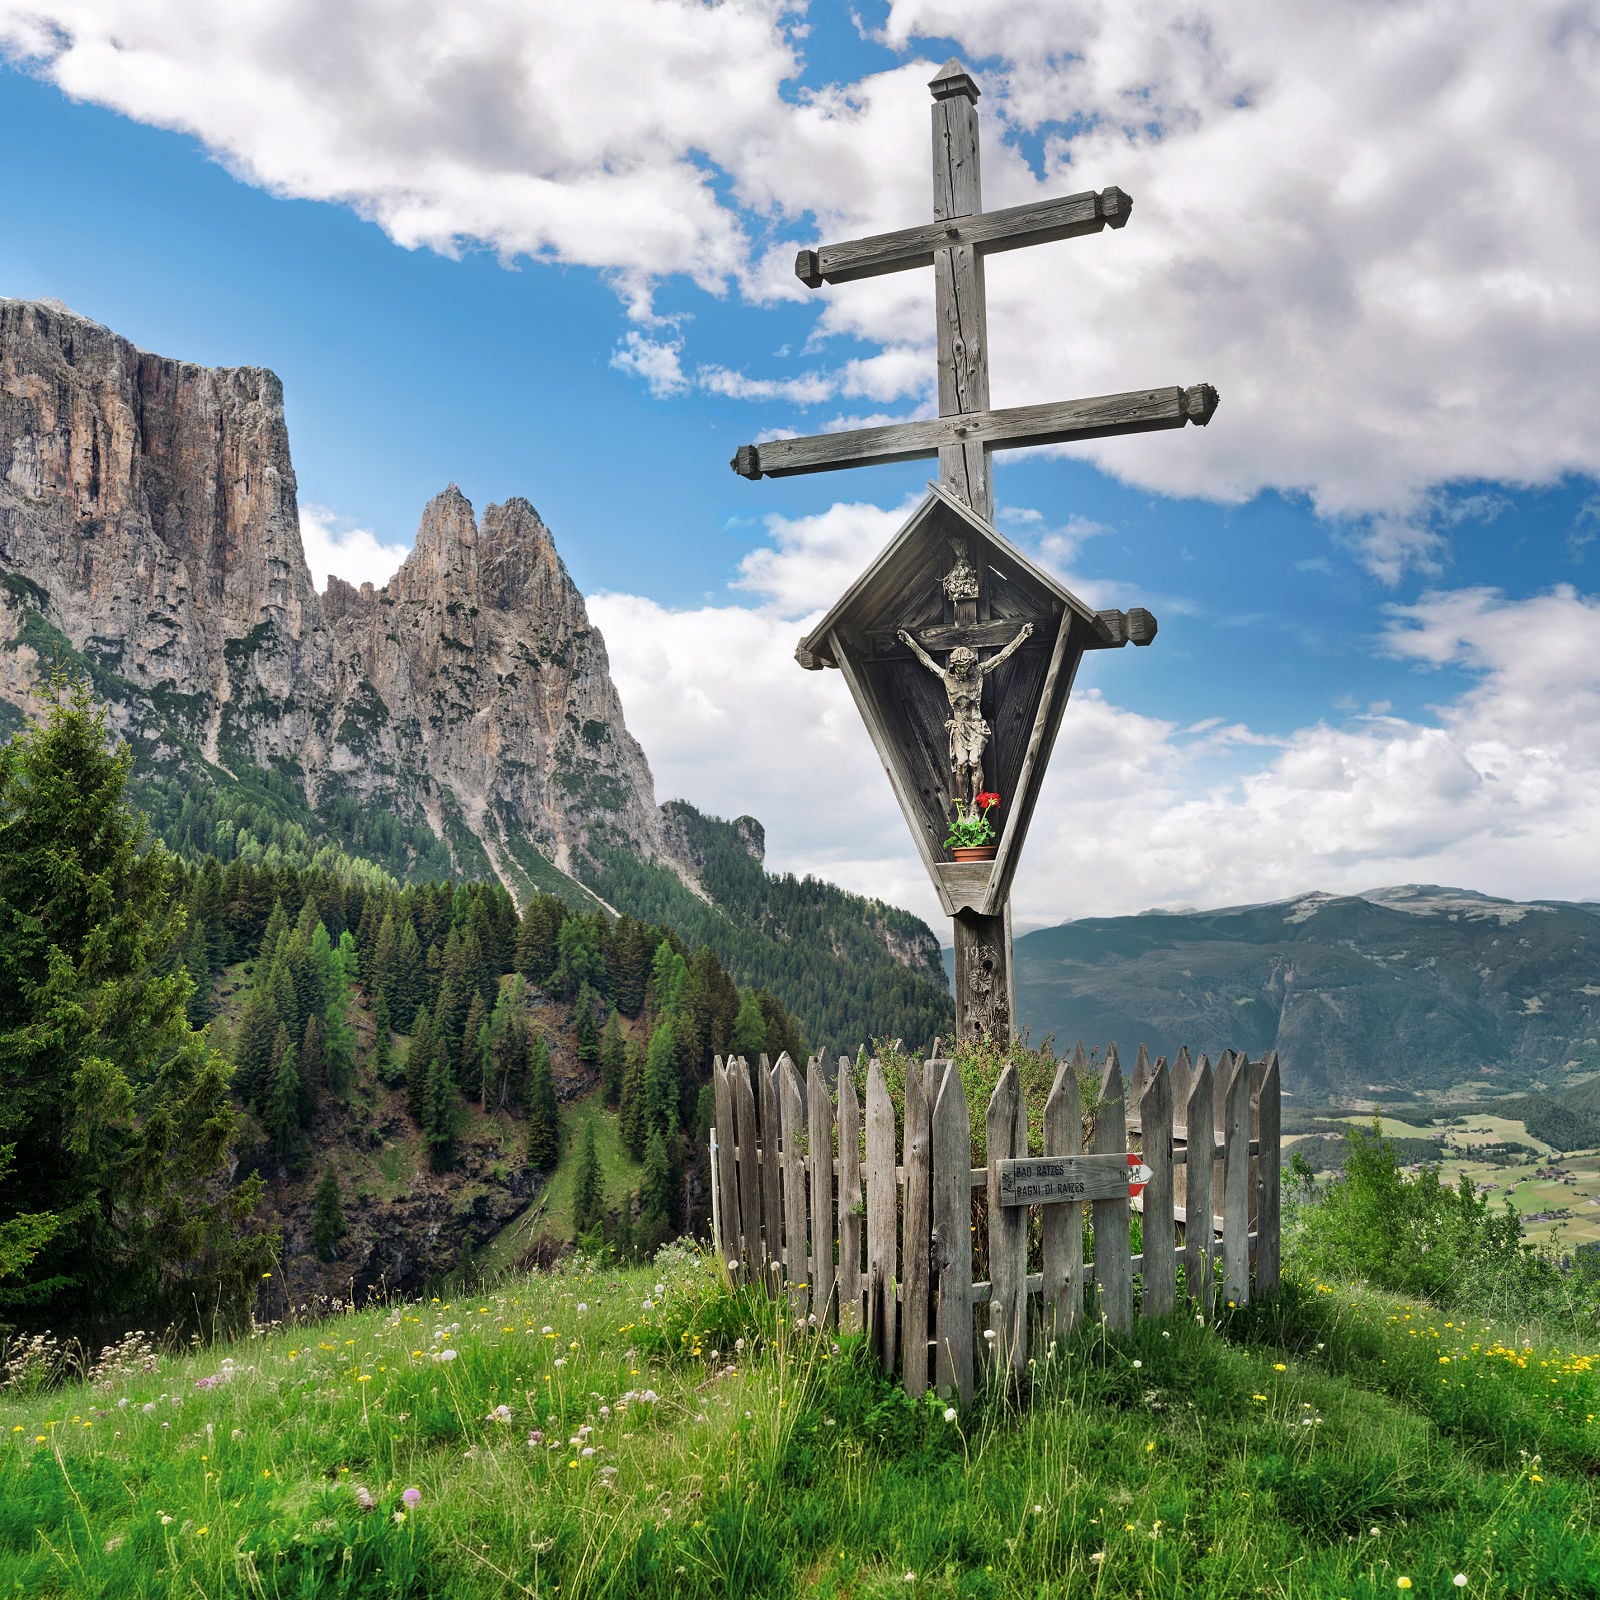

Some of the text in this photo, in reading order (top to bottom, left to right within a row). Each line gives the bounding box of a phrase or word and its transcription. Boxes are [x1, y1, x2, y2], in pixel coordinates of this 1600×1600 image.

[1036, 1164, 1065, 1177] RATZES
[1016, 1182, 1085, 1197] BAGNI DI RATZES
